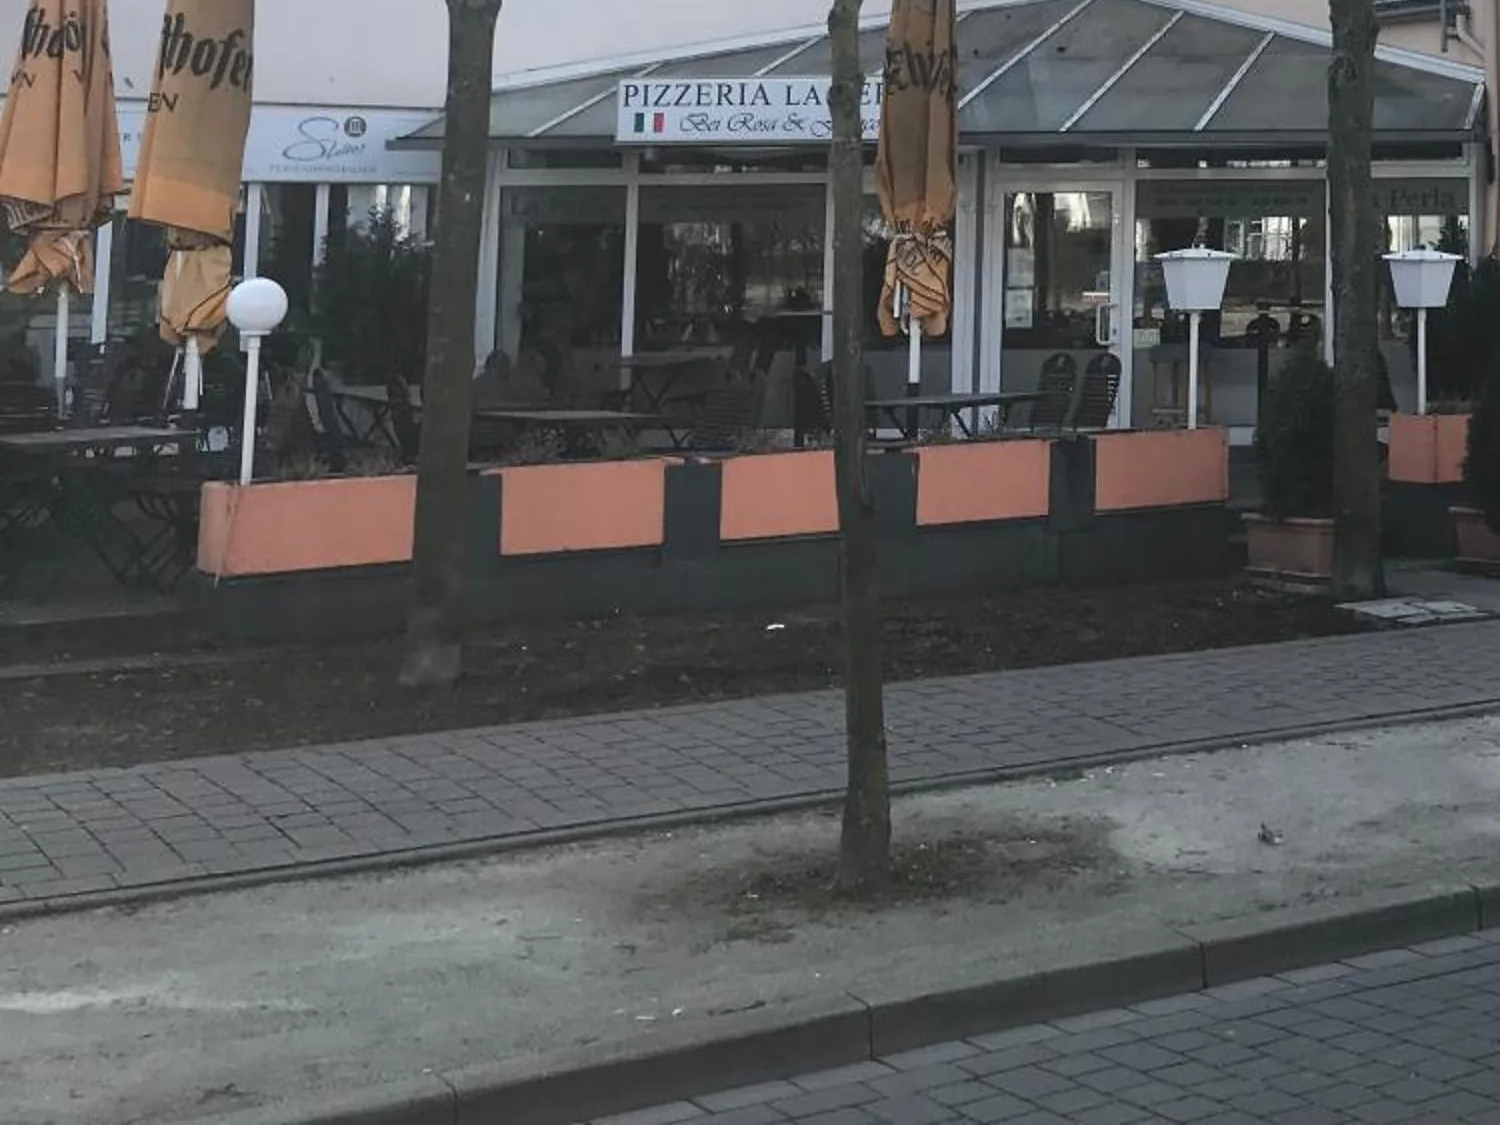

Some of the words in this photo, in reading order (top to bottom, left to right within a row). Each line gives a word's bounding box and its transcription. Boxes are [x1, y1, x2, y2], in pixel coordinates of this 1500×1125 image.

[623, 83, 771, 108] PIZZERIA
[785, 84, 822, 107] LA
[680, 112, 720, 132] Bei
[727, 111, 778, 132] Rosa
[782, 111, 807, 132] &
